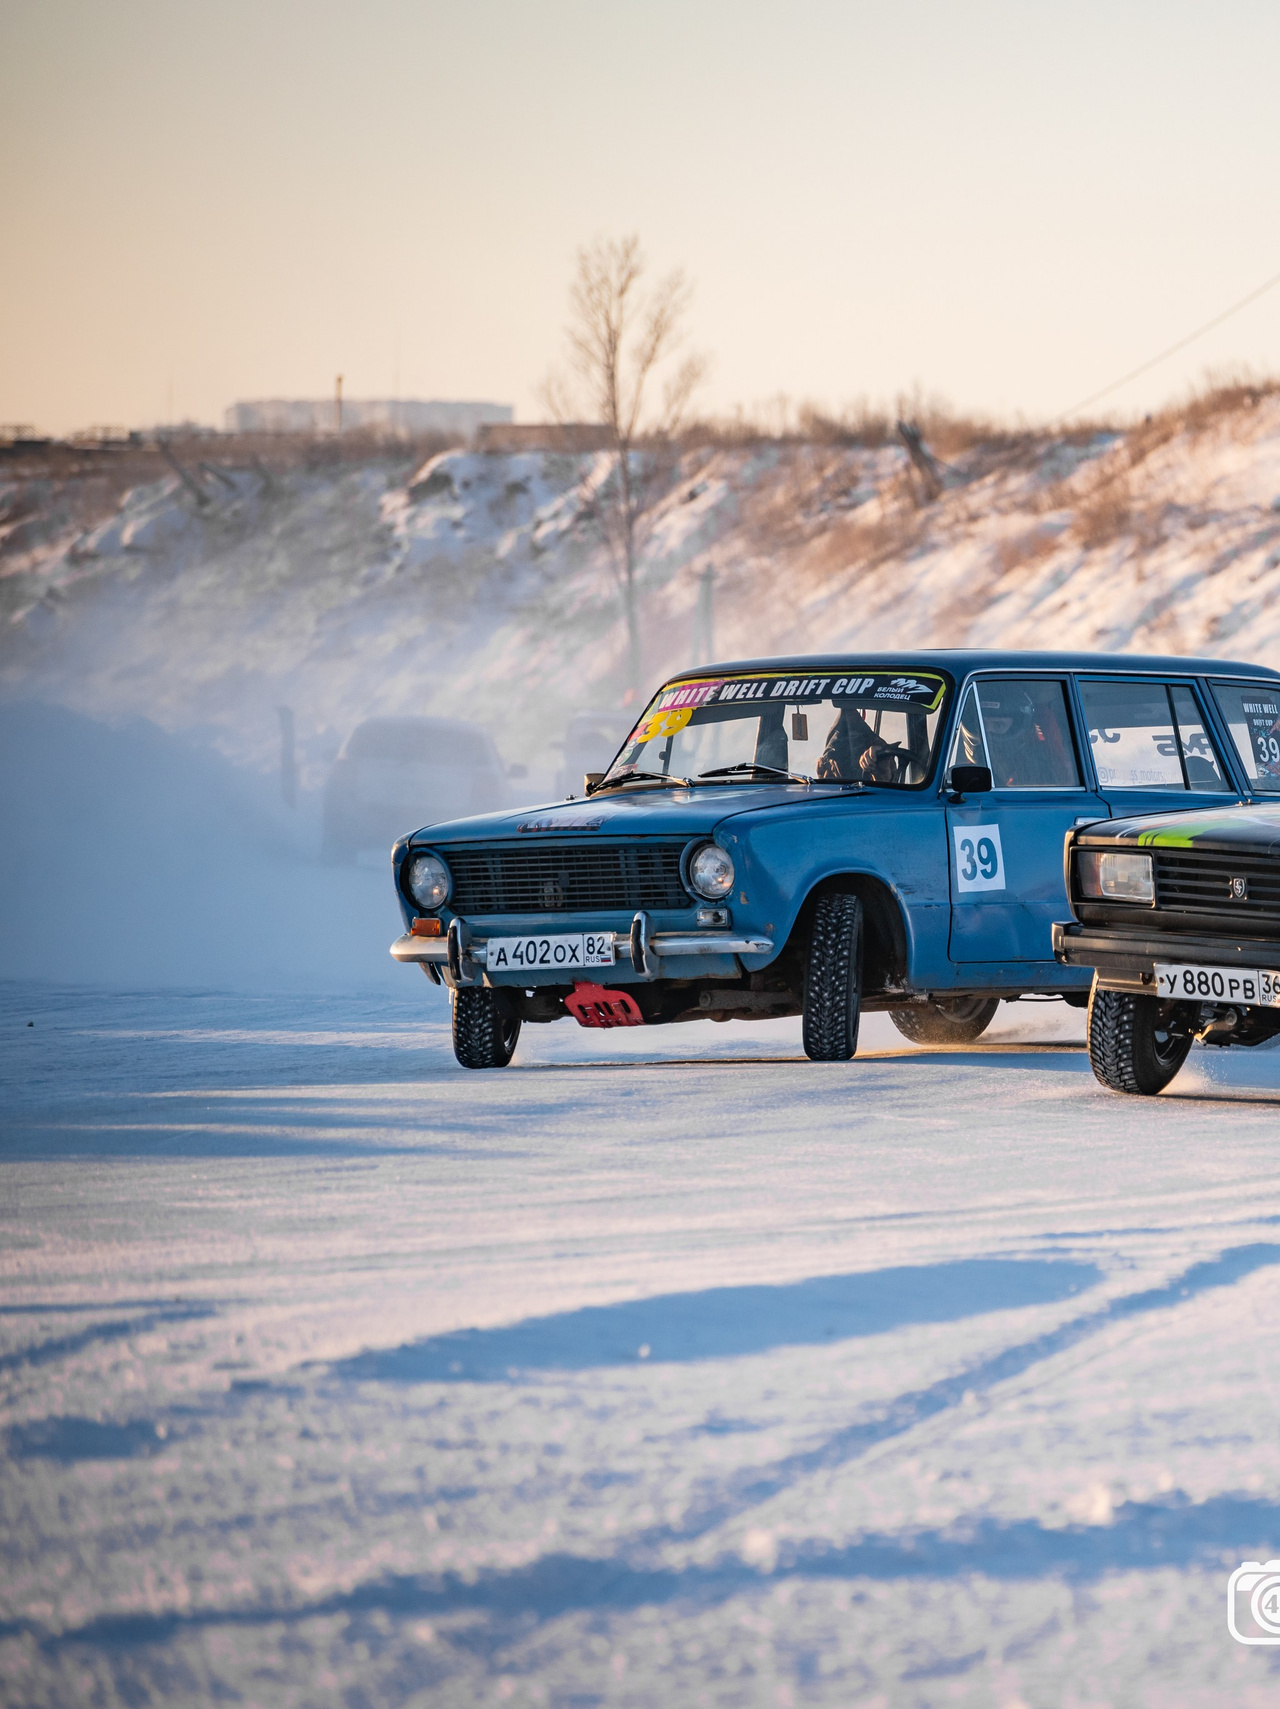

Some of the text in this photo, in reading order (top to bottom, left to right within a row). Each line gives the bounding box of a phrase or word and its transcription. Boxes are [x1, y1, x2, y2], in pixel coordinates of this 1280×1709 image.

[658, 678, 875, 710] WHITE WELL DRIFT CUP
[873, 692, 911, 701] КОЛОДЕЦ
[1242, 703, 1278, 714] WHITE WELL
[636, 707, 693, 744] 39
[1257, 736, 1280, 762] 39
[960, 837, 998, 880] 39
[586, 936, 605, 955] 82
[585, 955, 600, 963] RUS
[1261, 994, 1278, 1003] RUS
